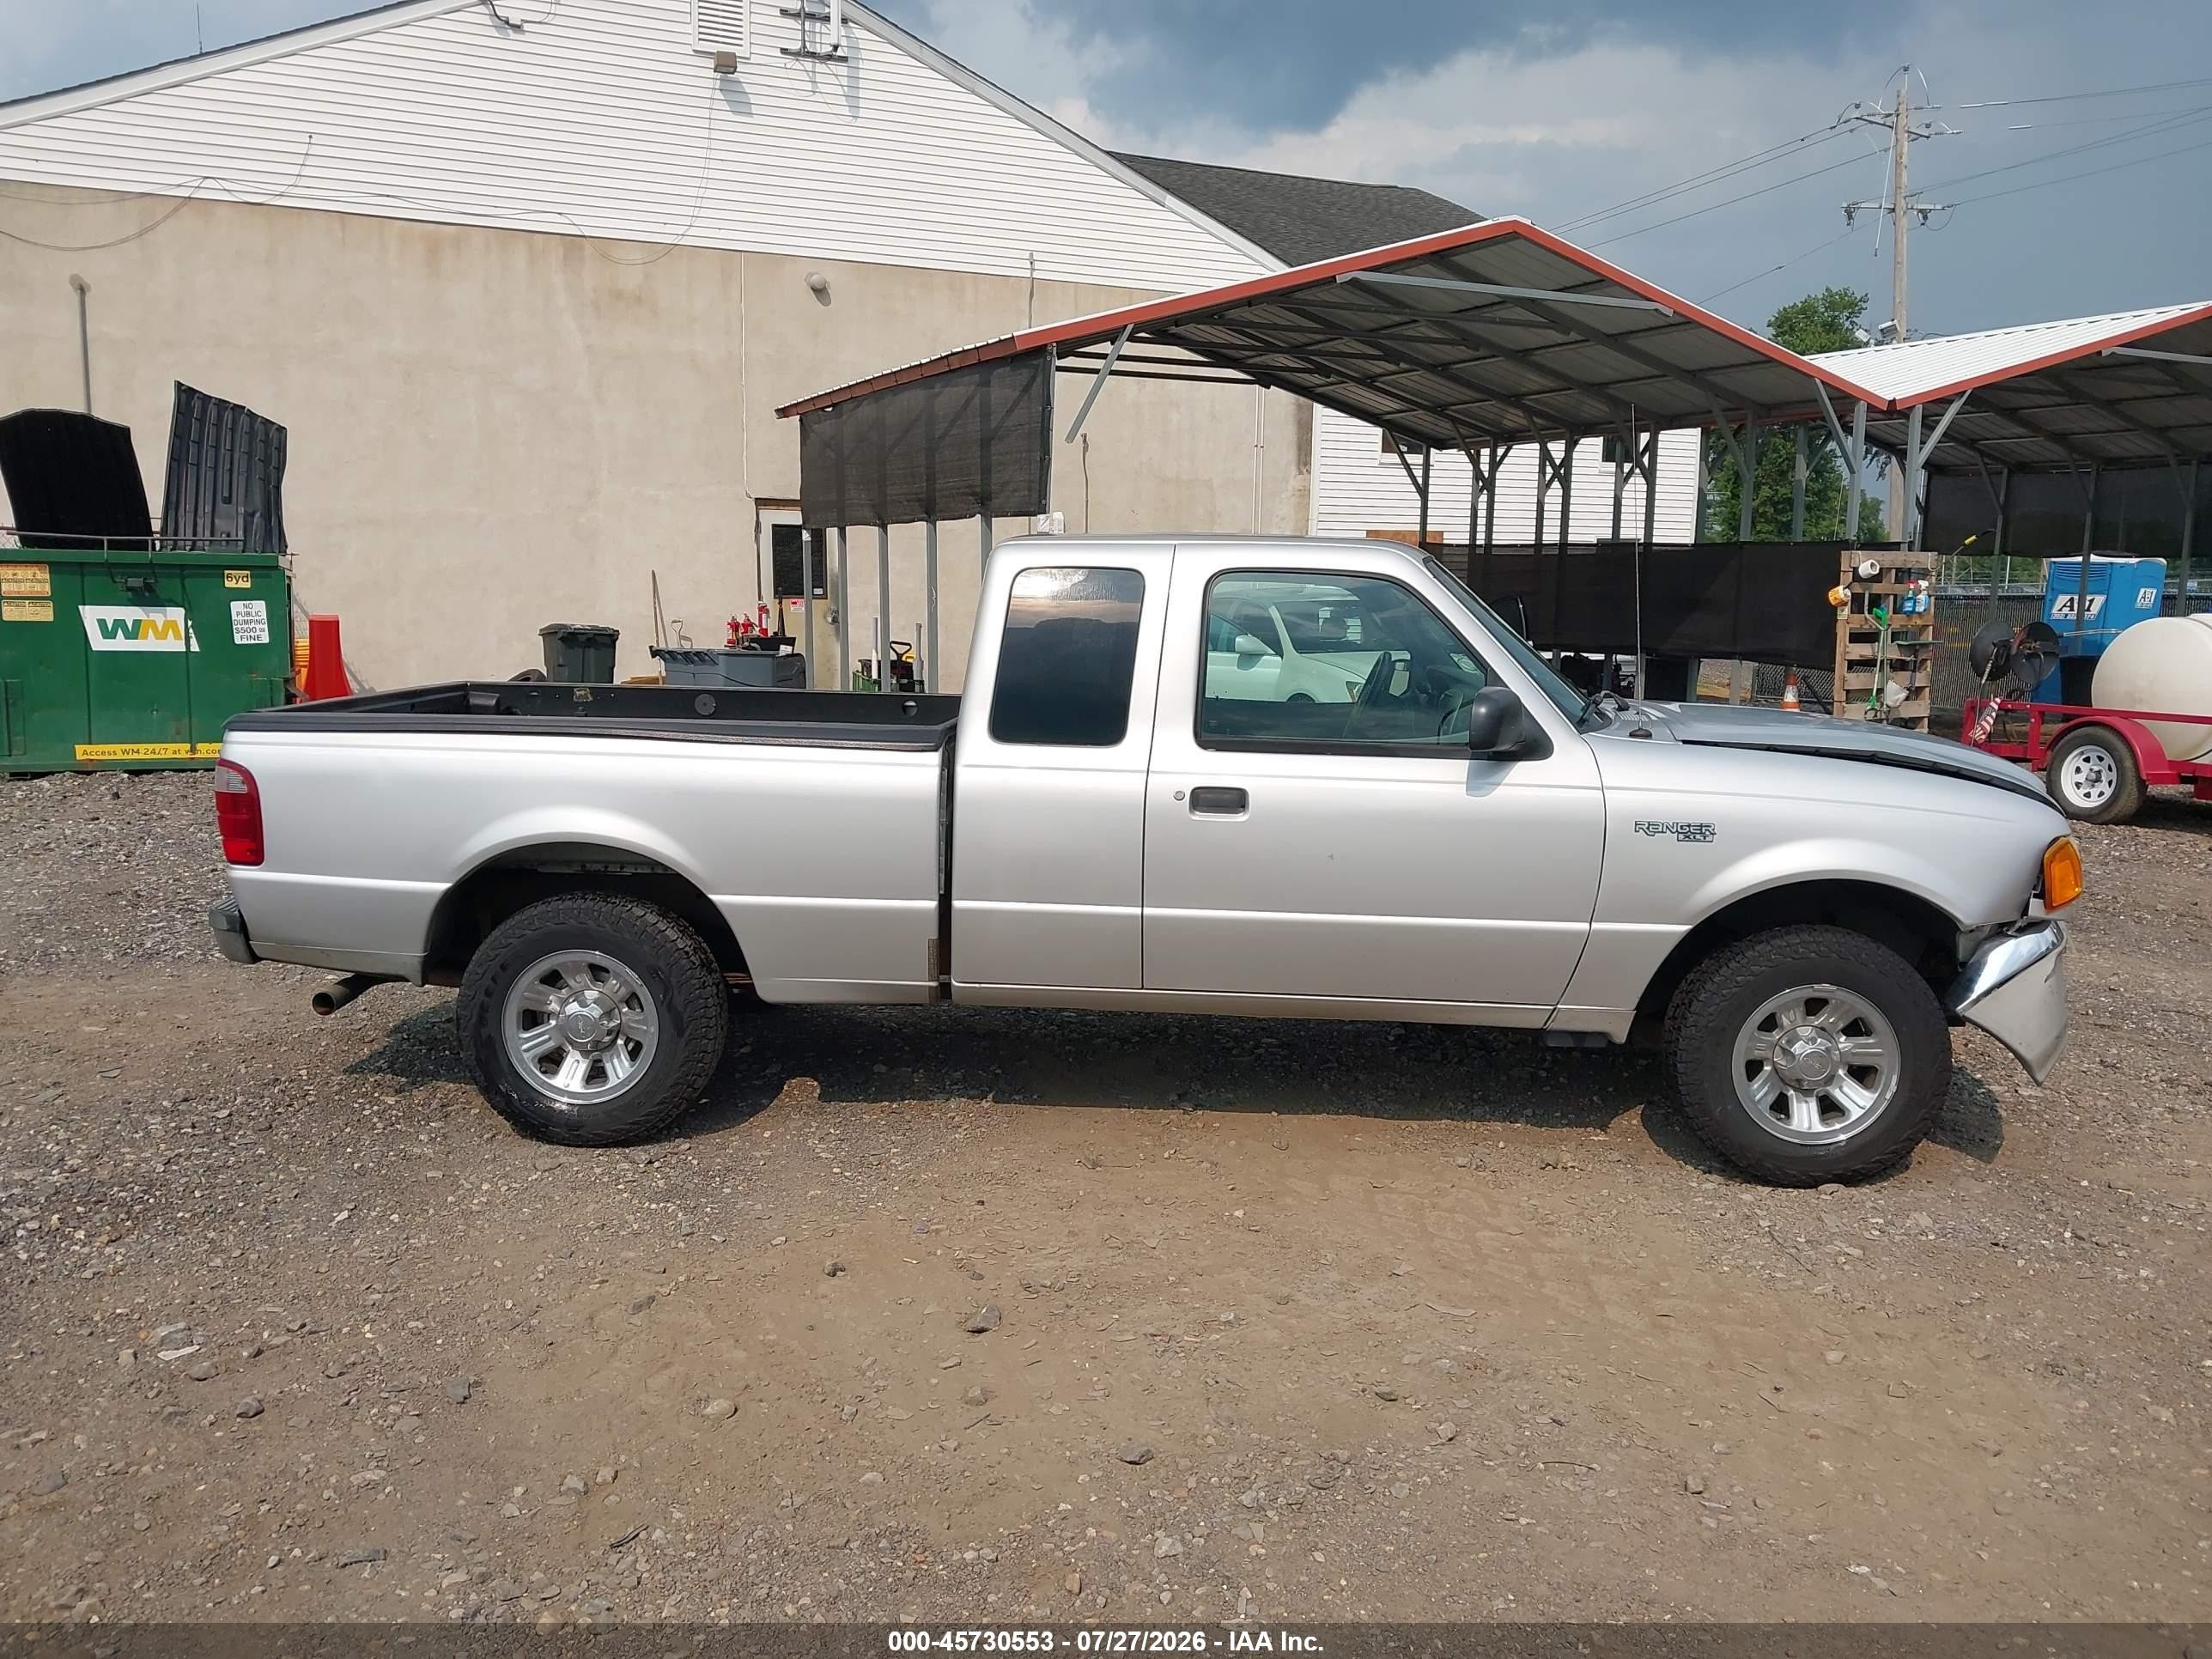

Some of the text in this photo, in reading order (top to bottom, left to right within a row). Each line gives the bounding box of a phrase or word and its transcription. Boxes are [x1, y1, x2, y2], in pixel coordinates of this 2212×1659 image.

[226, 573, 249, 585] 6yd
[96, 618, 183, 640] WM
[240, 634, 264, 642] FINE
[143, 747, 169, 756] 24/7
[1634, 821, 1717, 836] RANGER
